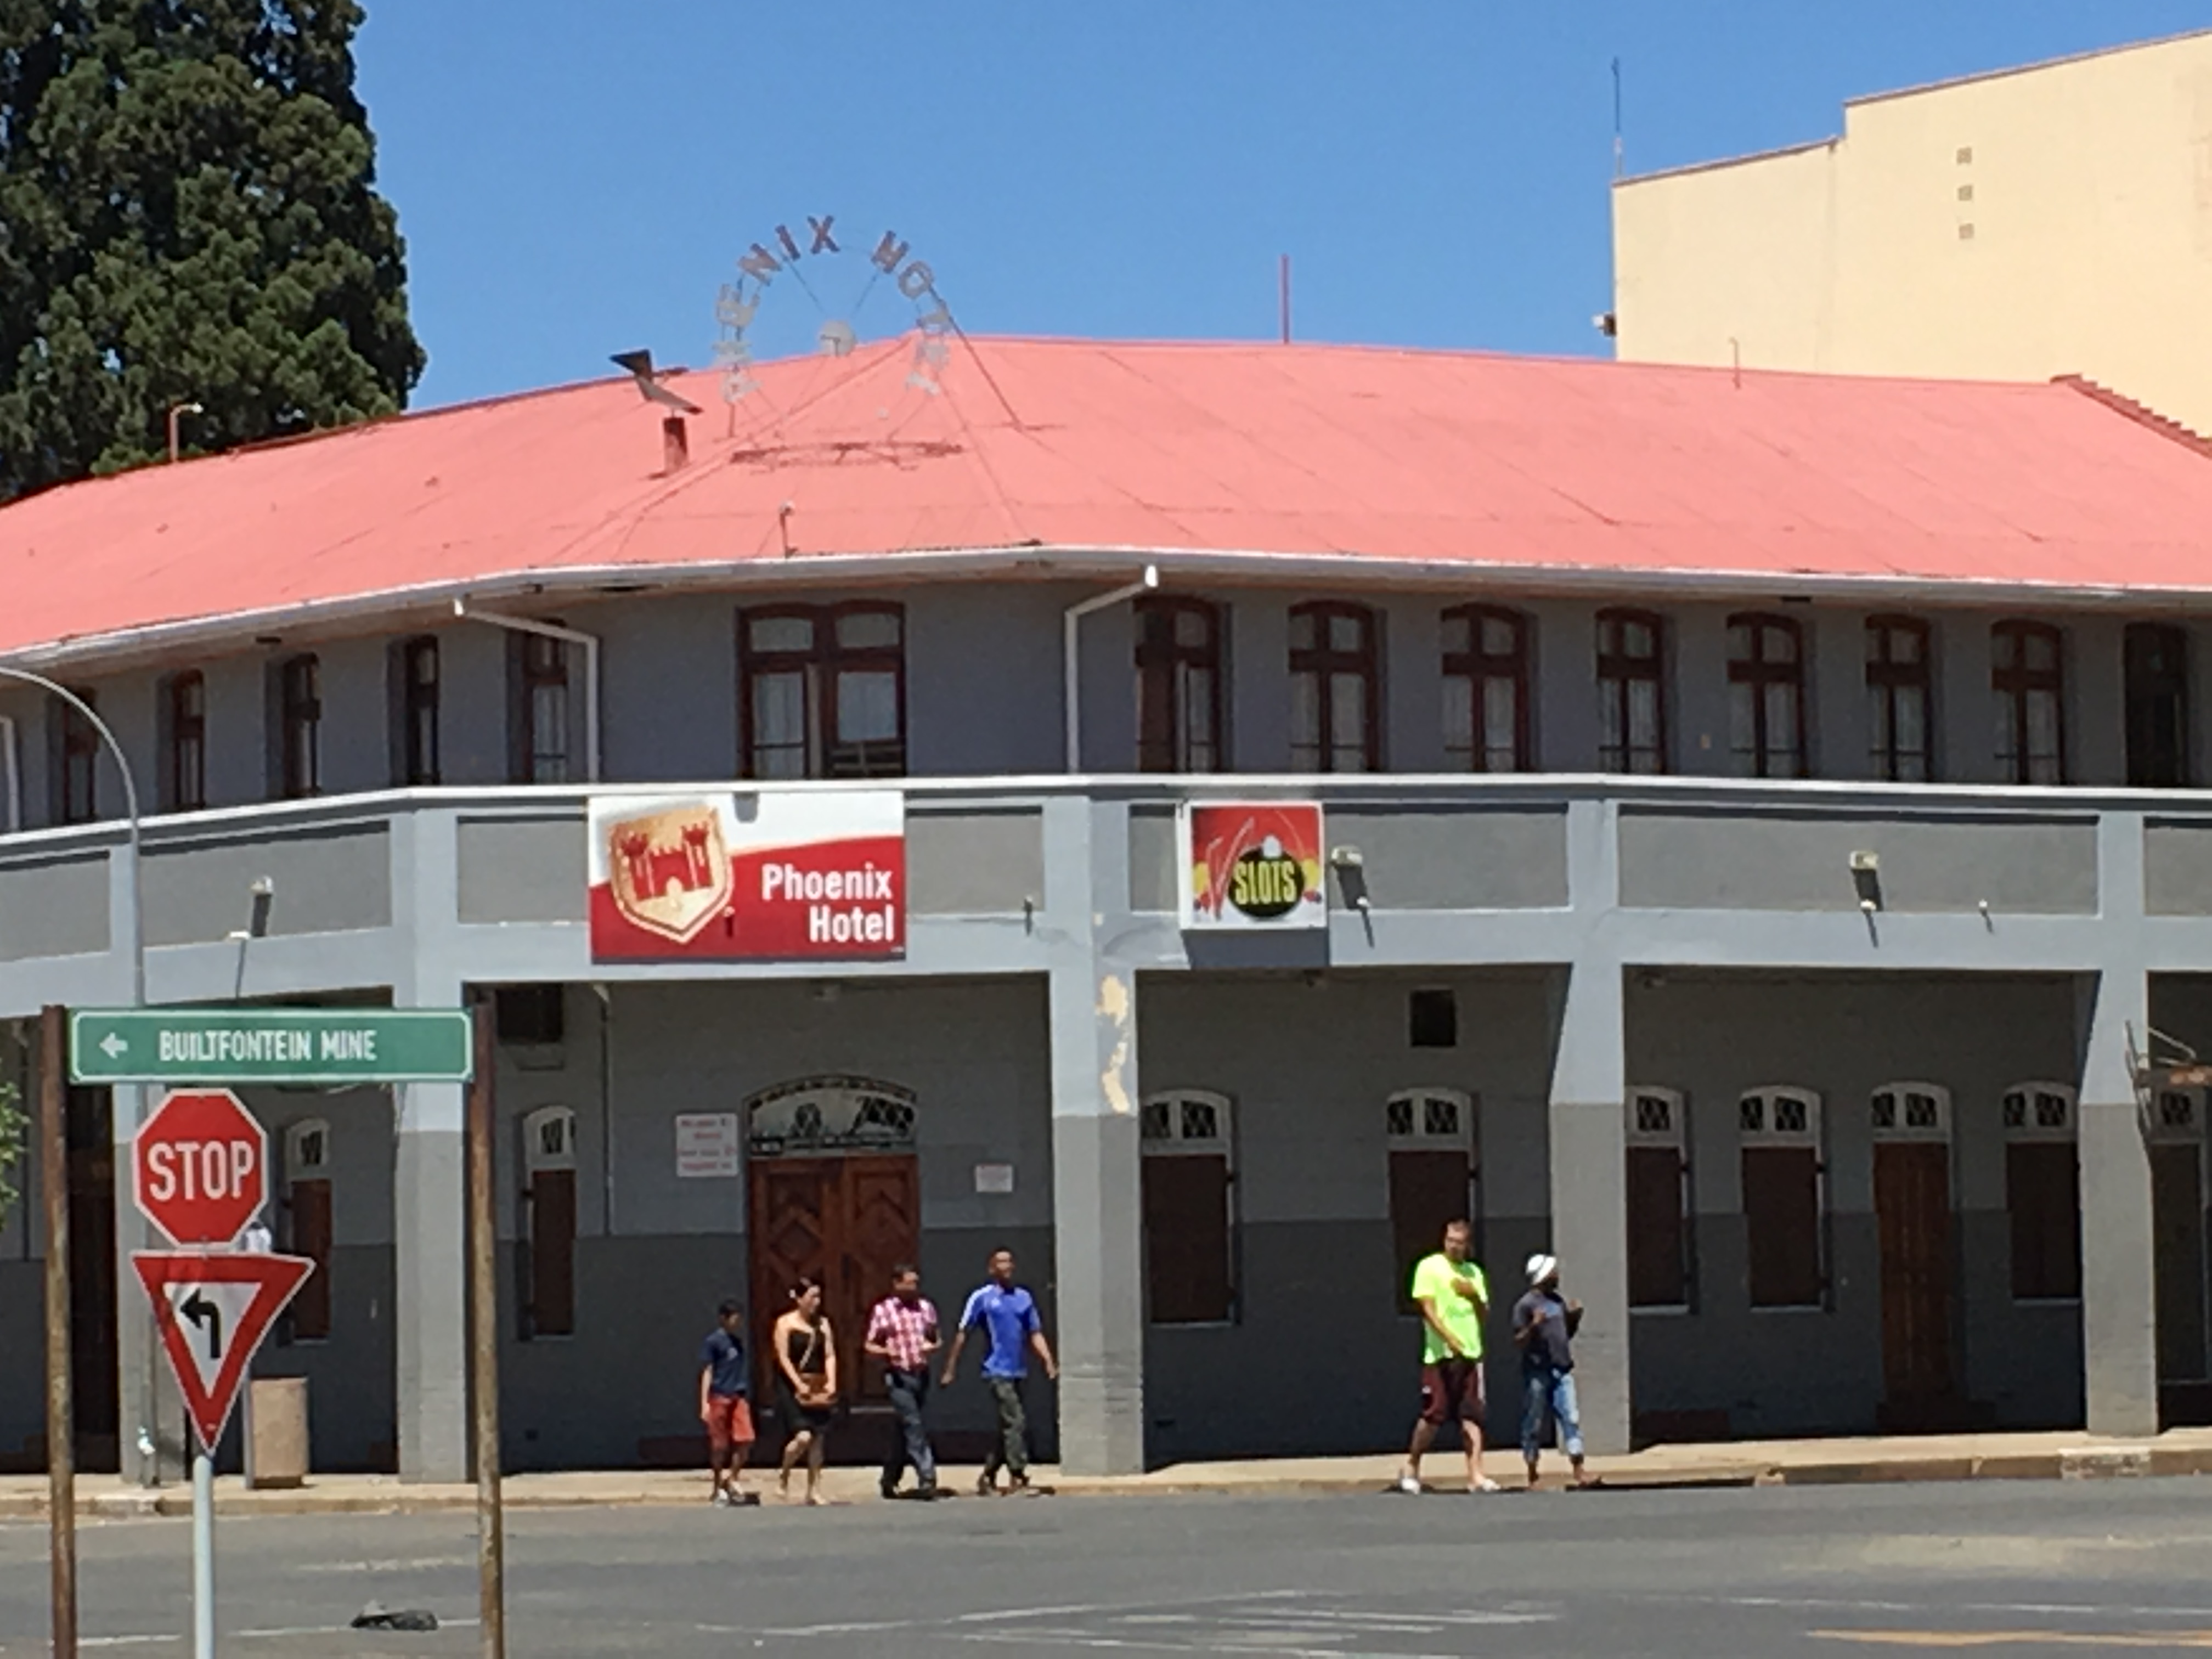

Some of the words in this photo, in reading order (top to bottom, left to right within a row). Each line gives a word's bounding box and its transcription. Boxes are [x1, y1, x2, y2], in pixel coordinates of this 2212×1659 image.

[761, 862, 893, 900] Phoenix
[1234, 860, 1297, 905] SLOTS
[809, 905, 894, 943] Hotel
[159, 1029, 312, 1062] BUILTFONTEIN
[320, 1029, 377, 1062] MINE
[147, 1141, 255, 1201] STOP
